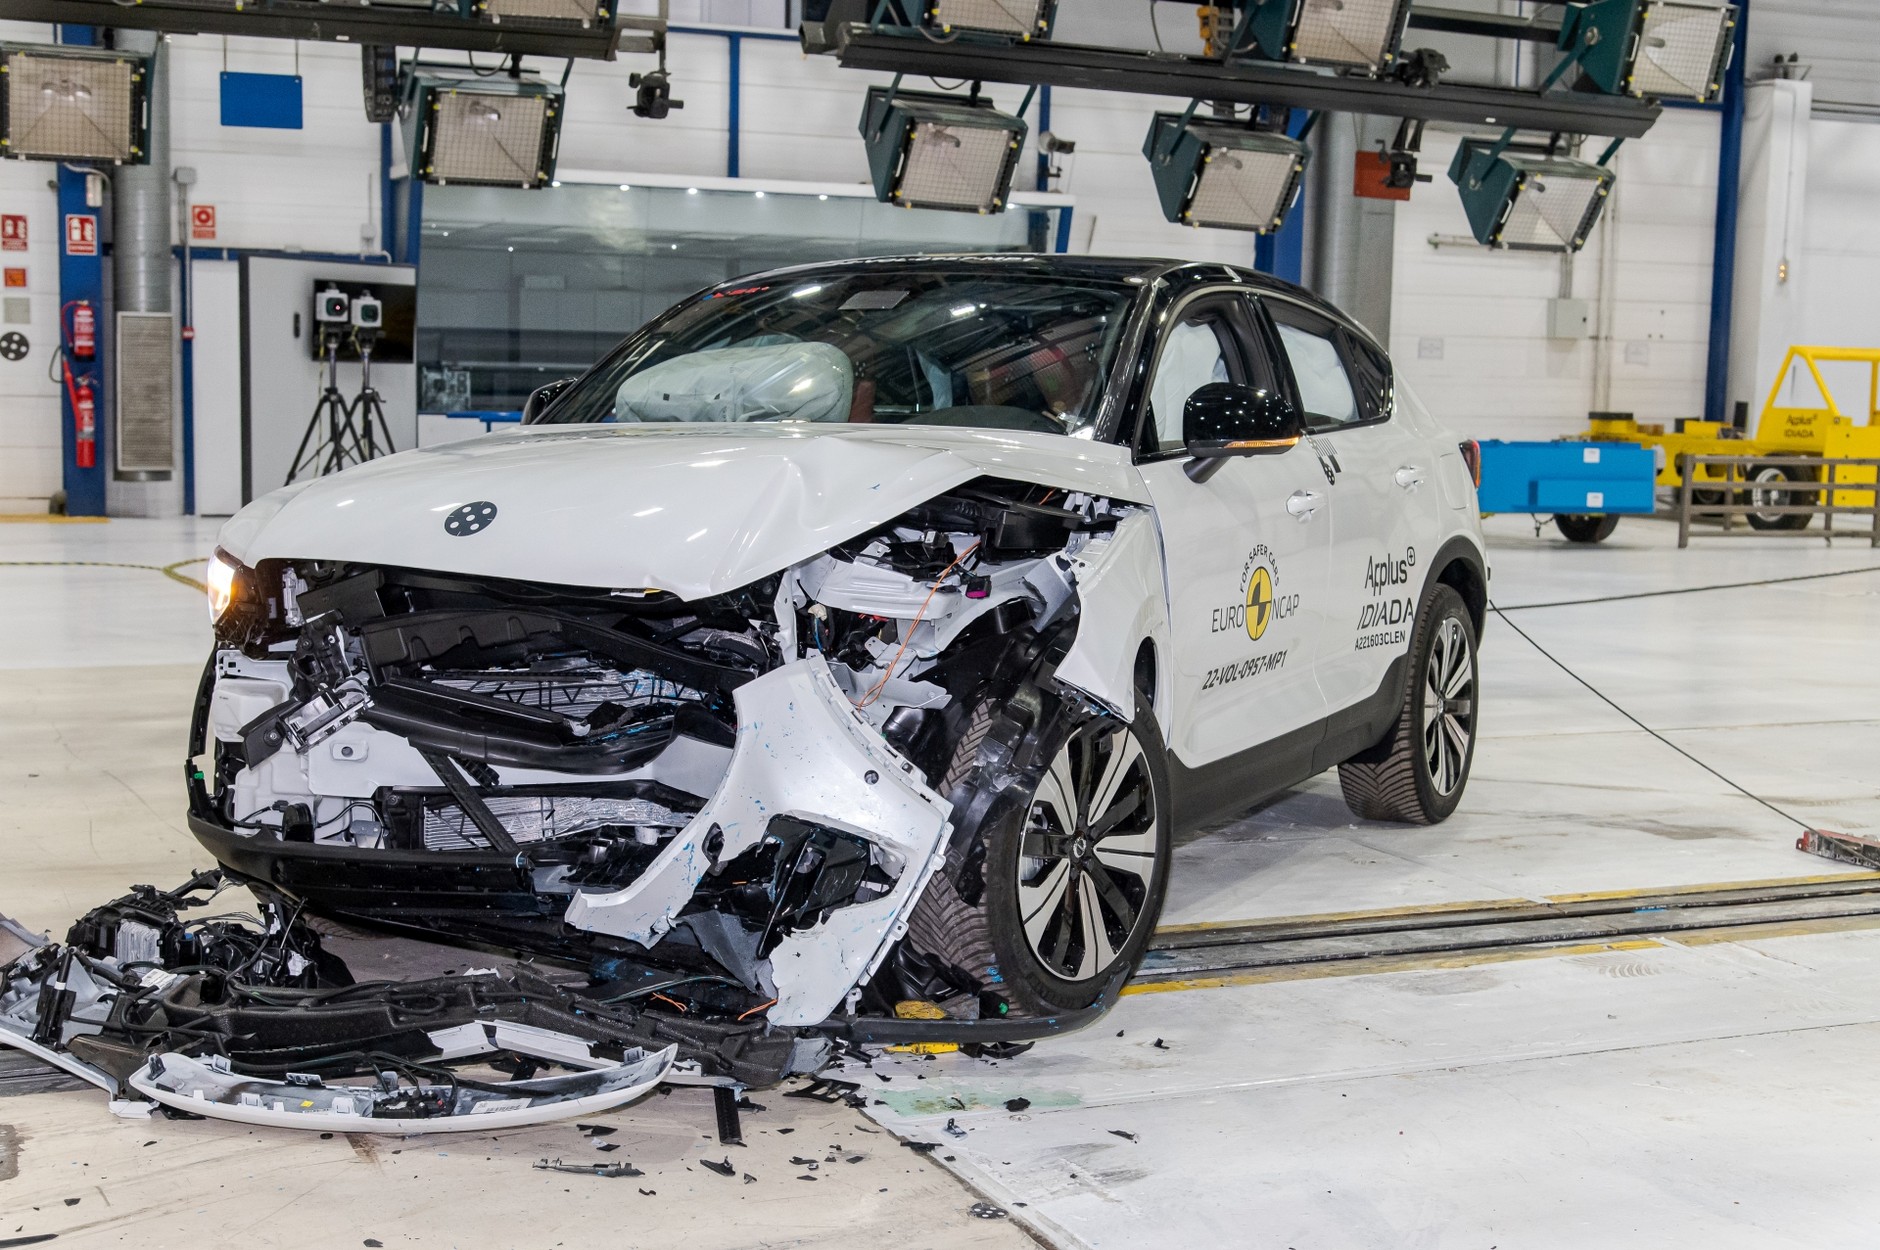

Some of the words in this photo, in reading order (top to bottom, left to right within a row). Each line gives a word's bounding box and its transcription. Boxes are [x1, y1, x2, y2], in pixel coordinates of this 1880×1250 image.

[1240, 562, 1250, 593] FOR
[1249, 544, 1268, 564] SAFER
[1268, 551, 1280, 587] CARS
[1211, 603, 1245, 633] EURO
[1271, 593, 1300, 620] NCAP
[1356, 597, 1415, 631] IDIADA
[1354, 630, 1406, 651] A221603CLEN
[1201, 649, 1288, 690] 22-VOL-0957-MP1
